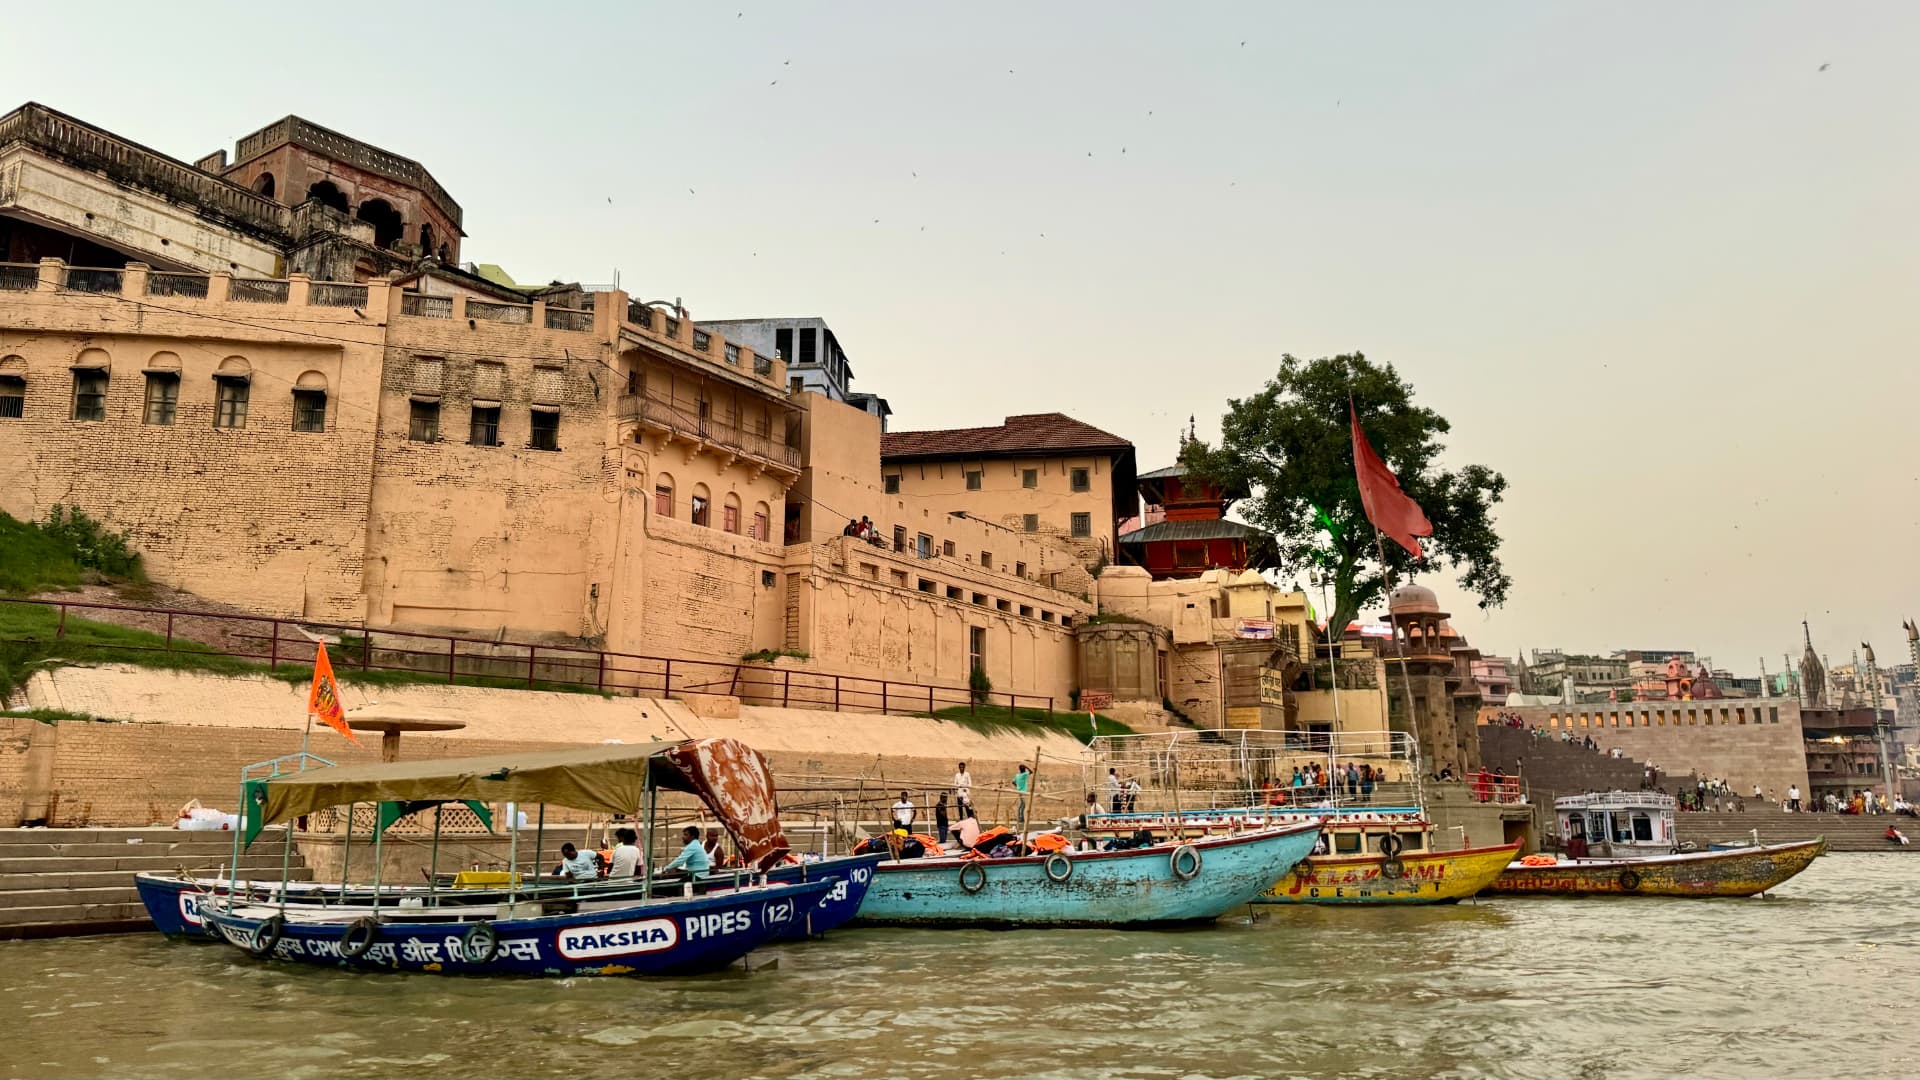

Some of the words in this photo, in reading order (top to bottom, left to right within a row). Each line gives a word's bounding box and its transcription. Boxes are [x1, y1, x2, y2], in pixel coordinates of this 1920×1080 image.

[850, 866, 872, 885] (10)
[565, 928, 668, 950] RAKSHA
[685, 909, 751, 941] PIPES
[761, 897, 794, 928] (12)
[400, 937, 444, 962] और
